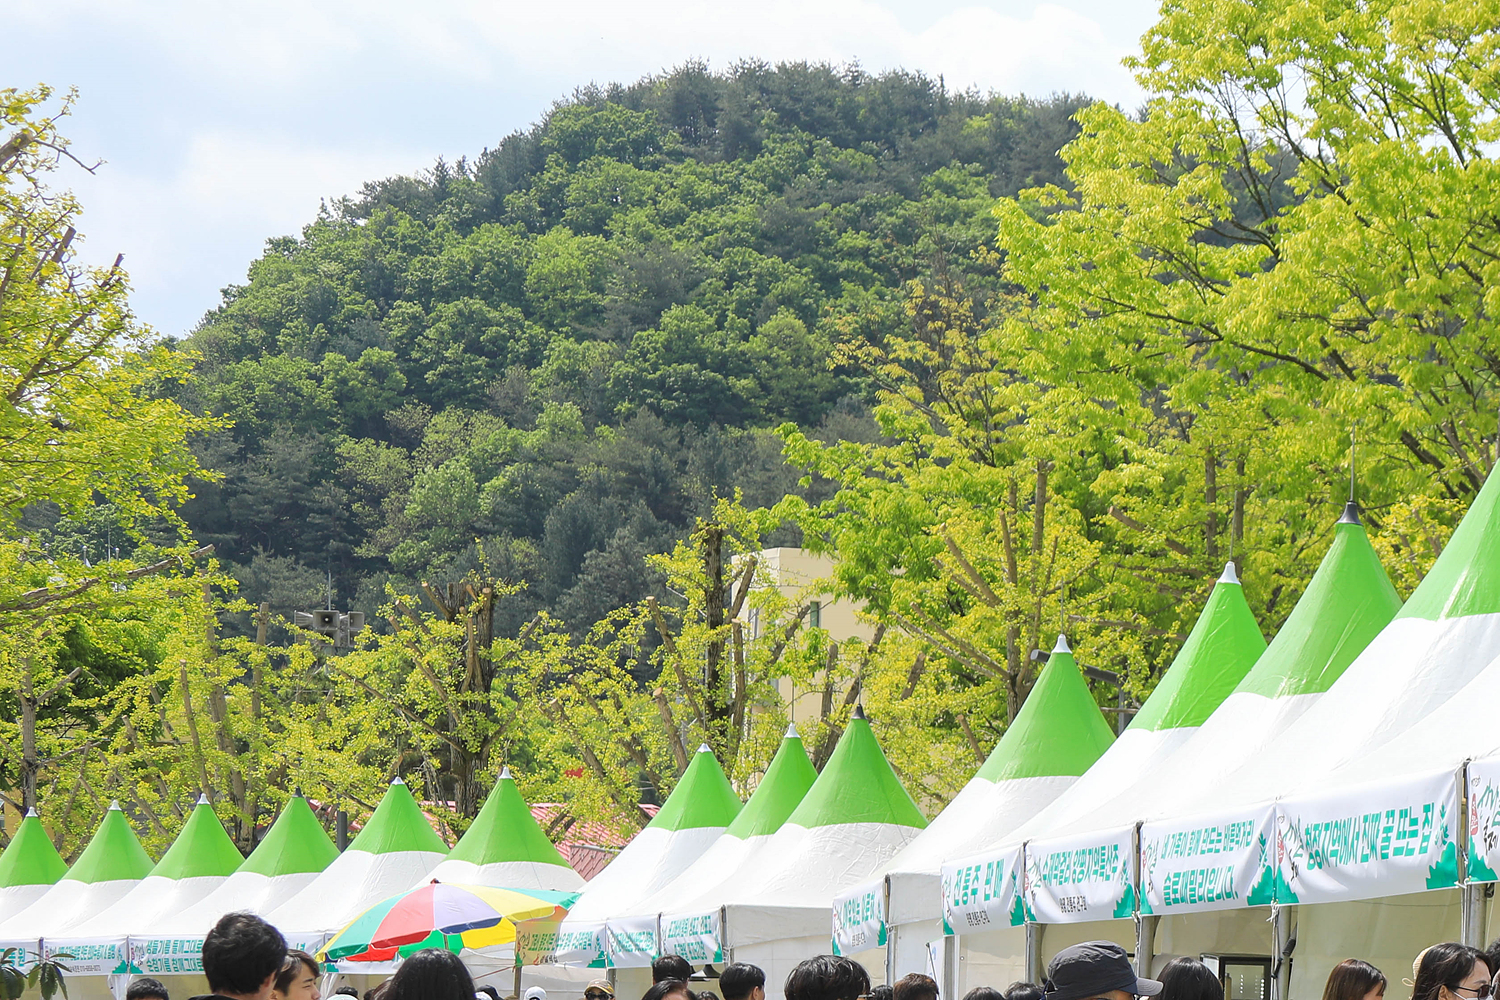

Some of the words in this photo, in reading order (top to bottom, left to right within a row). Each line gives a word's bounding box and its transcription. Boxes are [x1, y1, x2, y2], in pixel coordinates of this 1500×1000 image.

[1304, 815, 1361, 871] 청정지역에서
[1360, 811, 1382, 864] 진짜
[1380, 808, 1396, 860] 꿀
[1392, 805, 1419, 857] 뜨는
[1418, 801, 1435, 855] 집
[953, 864, 982, 907] 전통주
[983, 858, 1005, 902] 판매
